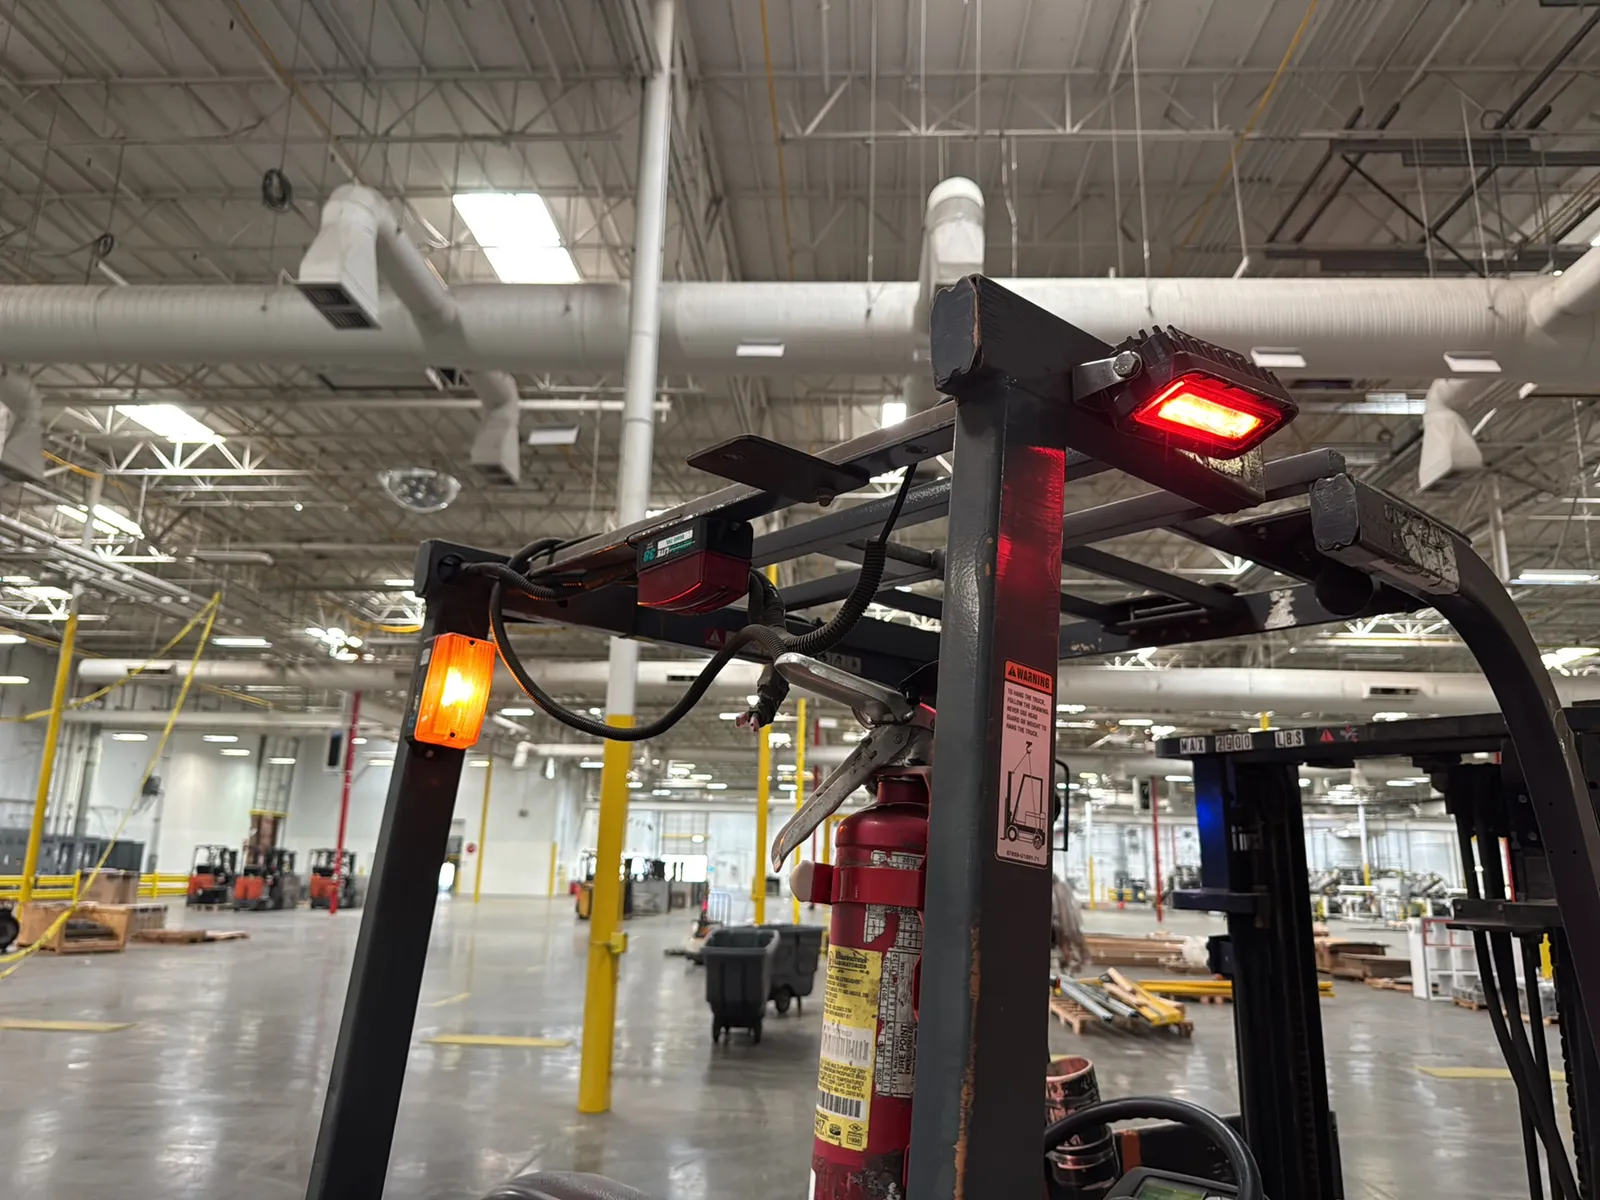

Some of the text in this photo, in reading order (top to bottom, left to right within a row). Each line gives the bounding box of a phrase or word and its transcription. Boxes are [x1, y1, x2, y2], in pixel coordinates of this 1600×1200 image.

[1017, 667, 1050, 689] WARNING
[1013, 690, 1024, 698] HANG
[1007, 697, 1023, 706] FOLLOW
[1007, 706, 1019, 714] NEVER
[1028, 712, 1038, 720] HEAD
[1006, 723, 1016, 731] HANG
[1007, 714, 1020, 723] GUARD
[1027, 720, 1041, 729] WEIGHT
[1180, 731, 1304, 752] MAX 2900 LBS
[900, 1025, 908, 1051] POINT
